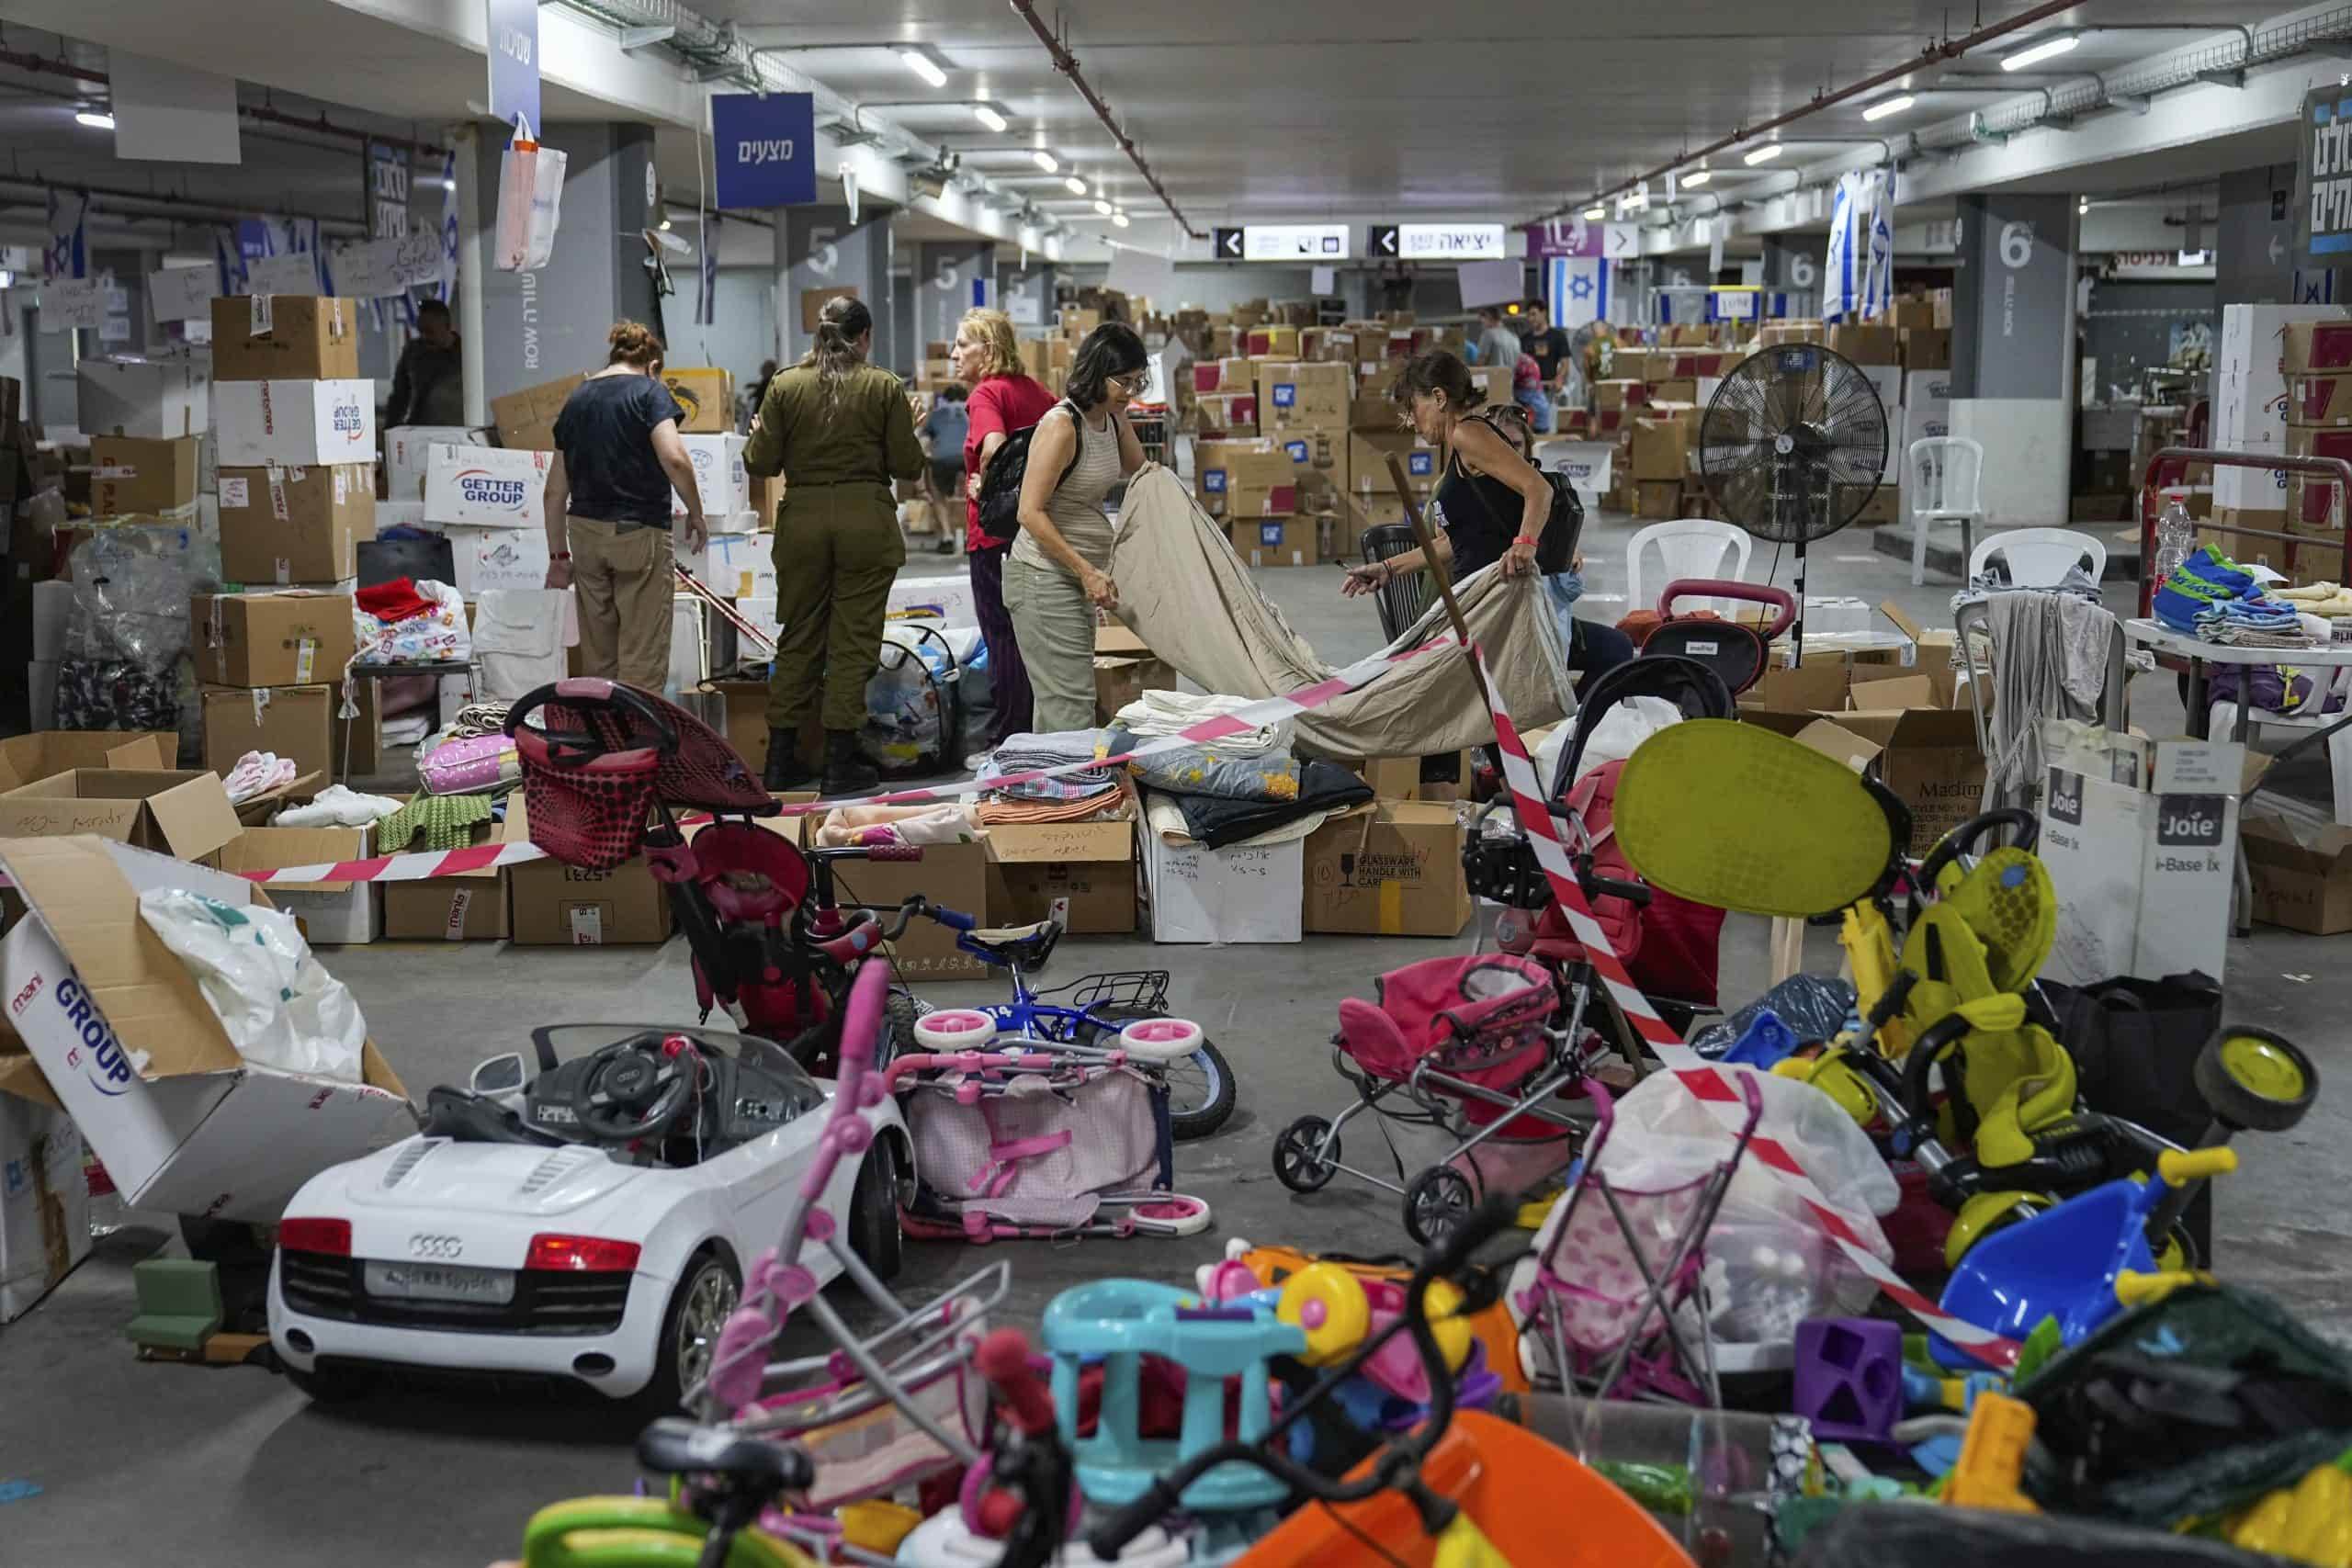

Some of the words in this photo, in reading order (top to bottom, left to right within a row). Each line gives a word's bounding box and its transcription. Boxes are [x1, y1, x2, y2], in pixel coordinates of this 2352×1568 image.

[738, 140, 794, 164] מצעים
[2313, 115, 2352, 176] ולנו
[2311, 177, 2352, 232] חים
[808, 227, 839, 275] 5
[1441, 232, 1492, 251] יציאה
[2000, 222, 2032, 268] 6
[935, 256, 957, 289] 5
[1792, 253, 1815, 287] 6
[525, 326, 538, 368] ROW
[461, 478, 525, 493] GETTER
[465, 490, 523, 504] GROUP
[2051, 790, 2078, 816] Joie
[2164, 811, 2214, 837] Joie
[1359, 854, 1416, 865] GLASSWARE
[1359, 867, 1396, 877] HANDLE
[1398, 867, 1421, 878] WITH
[2155, 856, 2202, 872] i-Base
[56, 978, 131, 1083] GROUP
